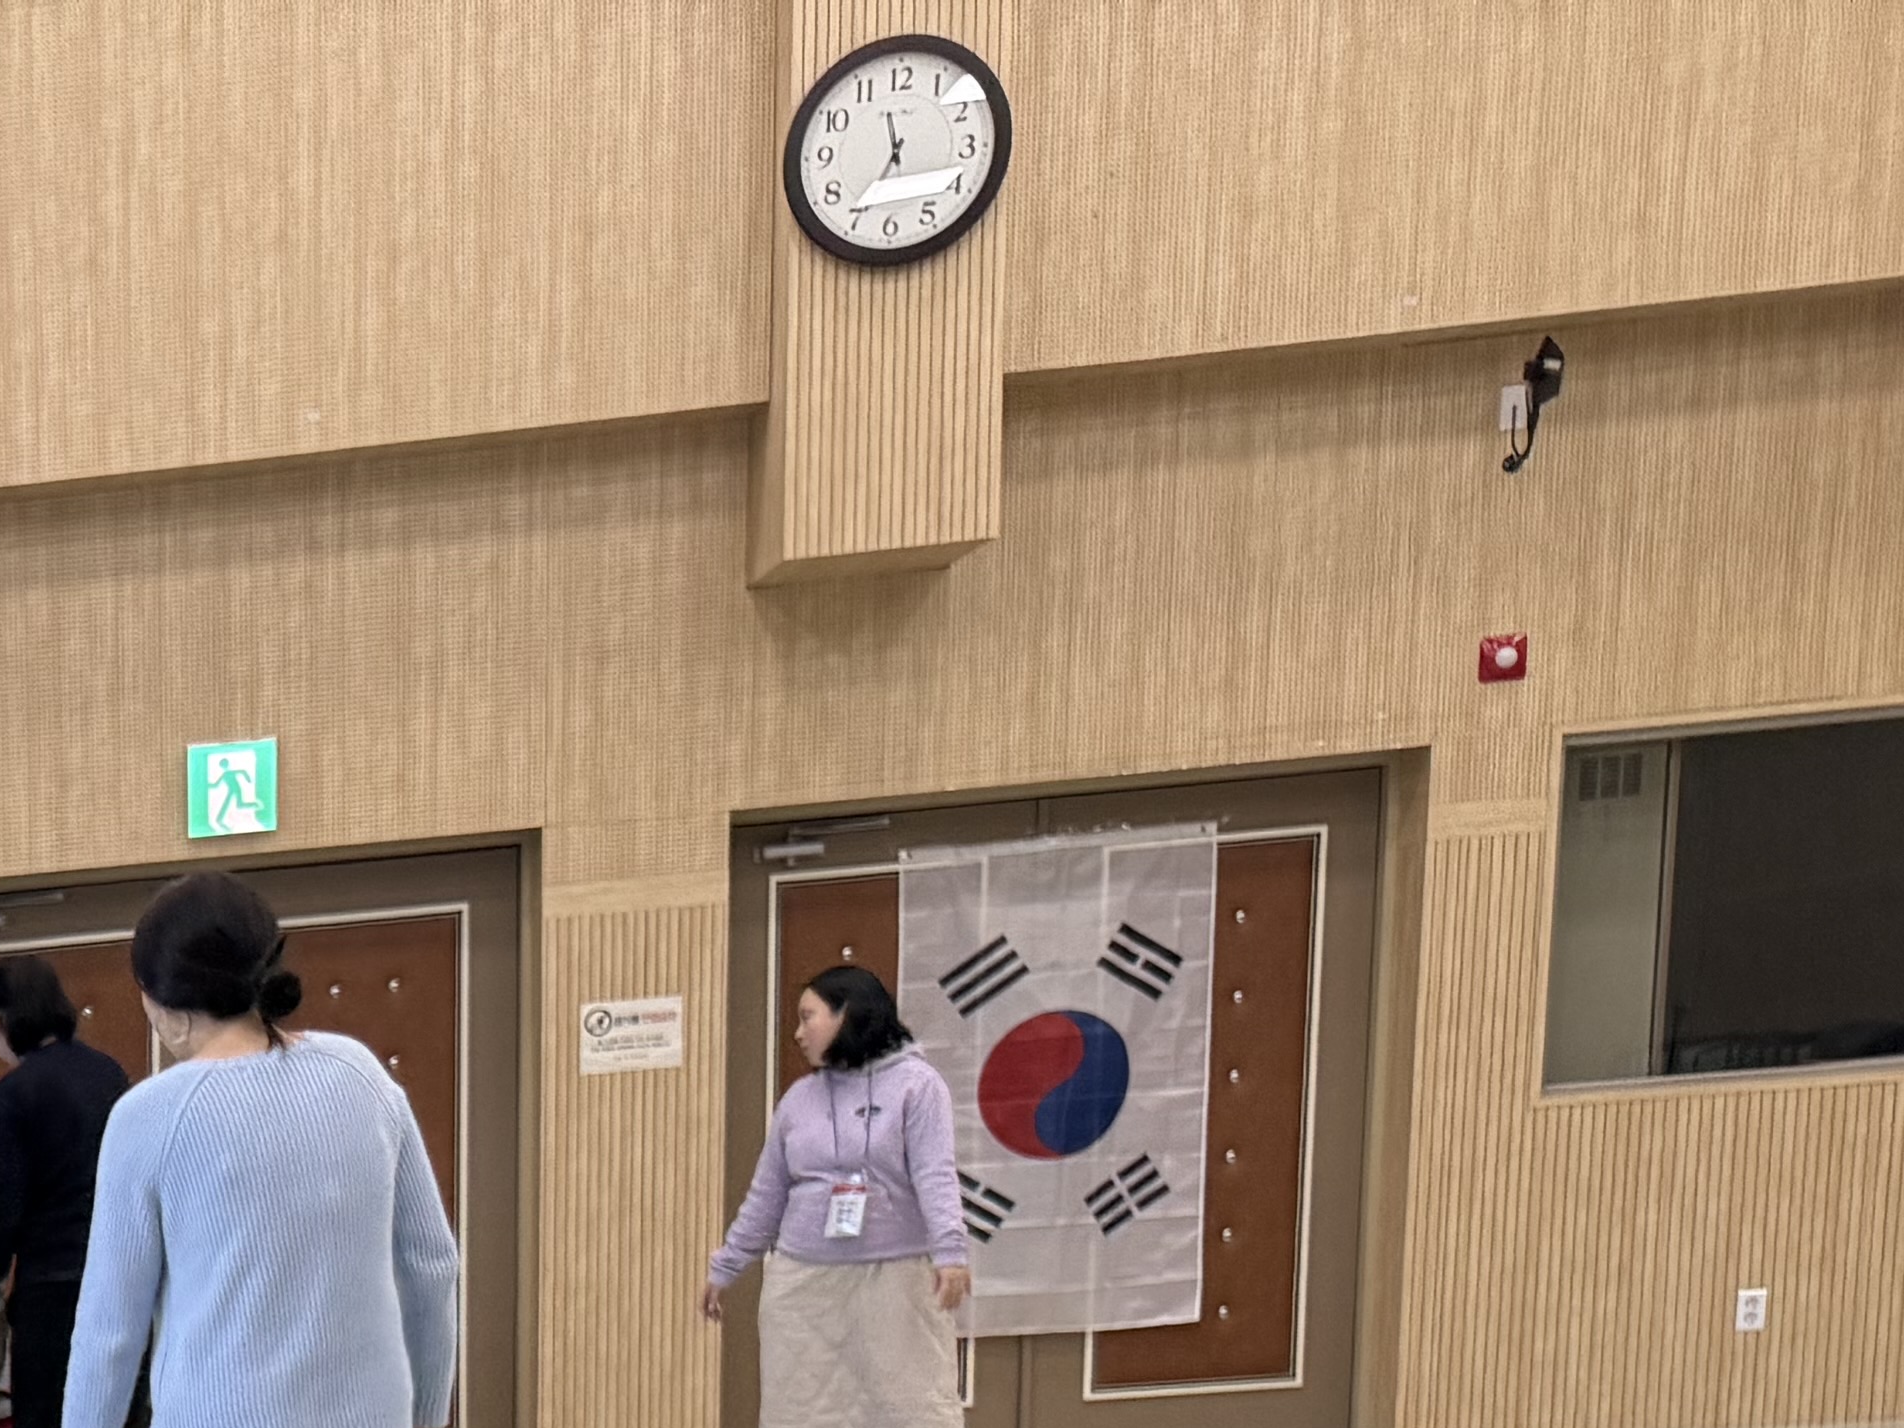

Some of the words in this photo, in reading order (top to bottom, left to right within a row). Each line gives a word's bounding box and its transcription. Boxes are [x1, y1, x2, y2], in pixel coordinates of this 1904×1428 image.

[856, 79, 873, 103] 11
[892, 67, 913, 91] 12
[934, 73, 941, 97] 1
[825, 108, 850, 133] 10
[954, 101, 968, 122] 2
[817, 146, 834, 169] 9
[958, 134, 976, 159] 3
[824, 180, 841, 205] 8
[945, 172, 962, 195] 4
[849, 206, 869, 231] 7
[919, 201, 937, 226] 5
[882, 215, 899, 237] 6
